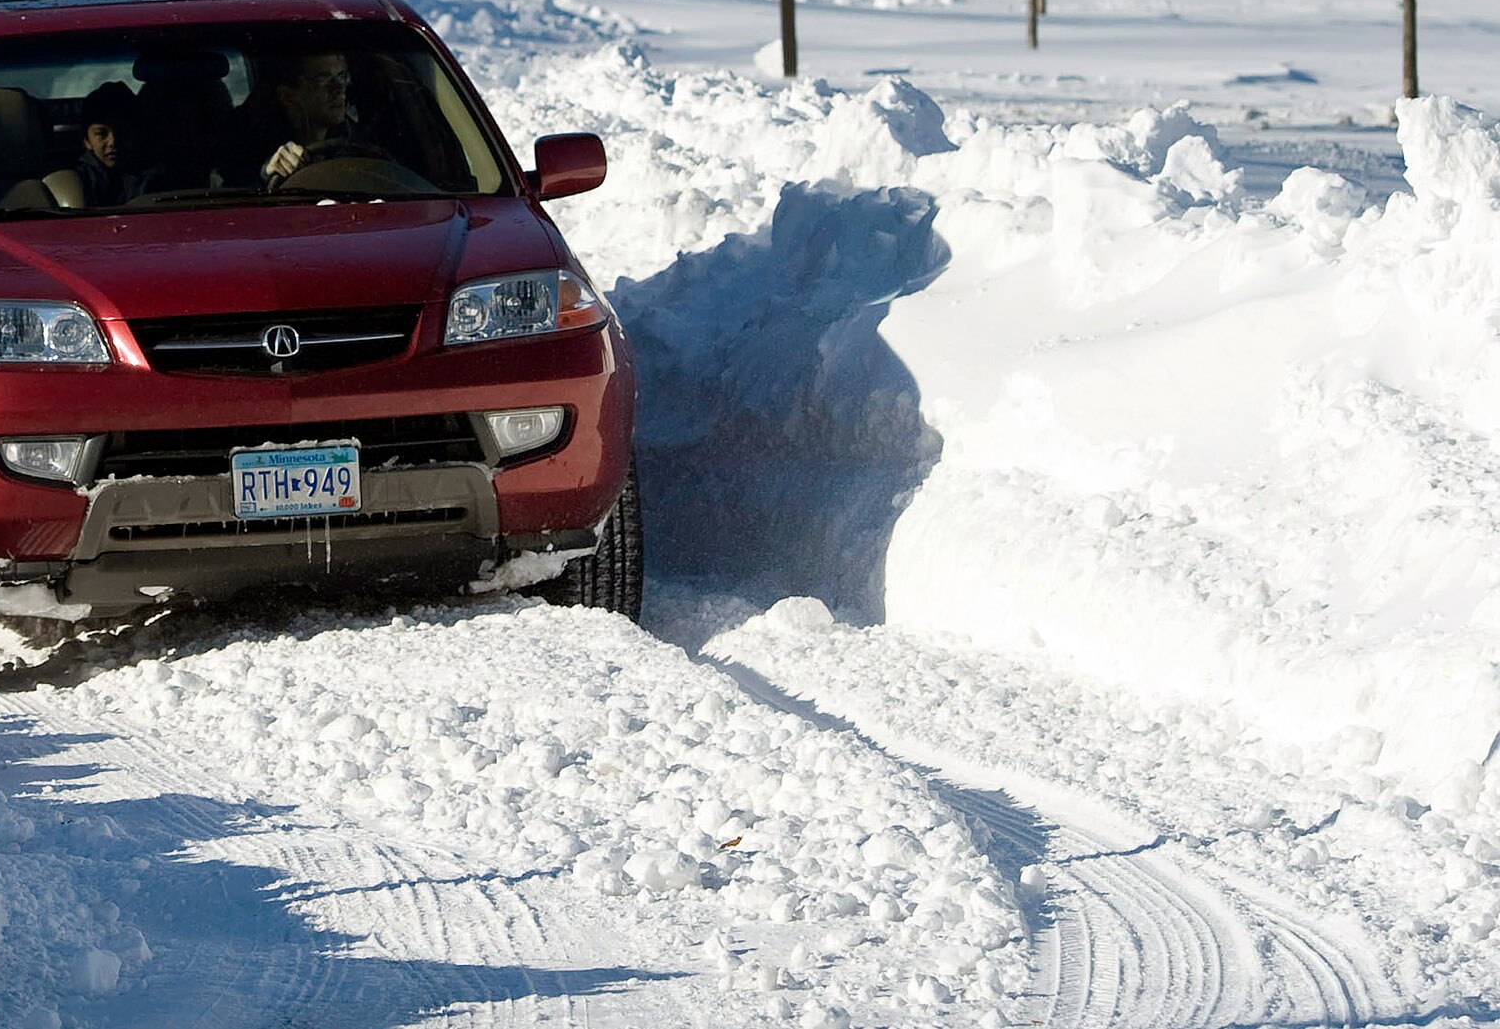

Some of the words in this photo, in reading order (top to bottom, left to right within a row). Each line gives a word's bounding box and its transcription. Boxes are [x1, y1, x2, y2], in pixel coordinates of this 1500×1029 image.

[269, 454, 326, 465] Minnesota
[242, 470, 290, 502] RTH
[304, 467, 351, 497] 949
